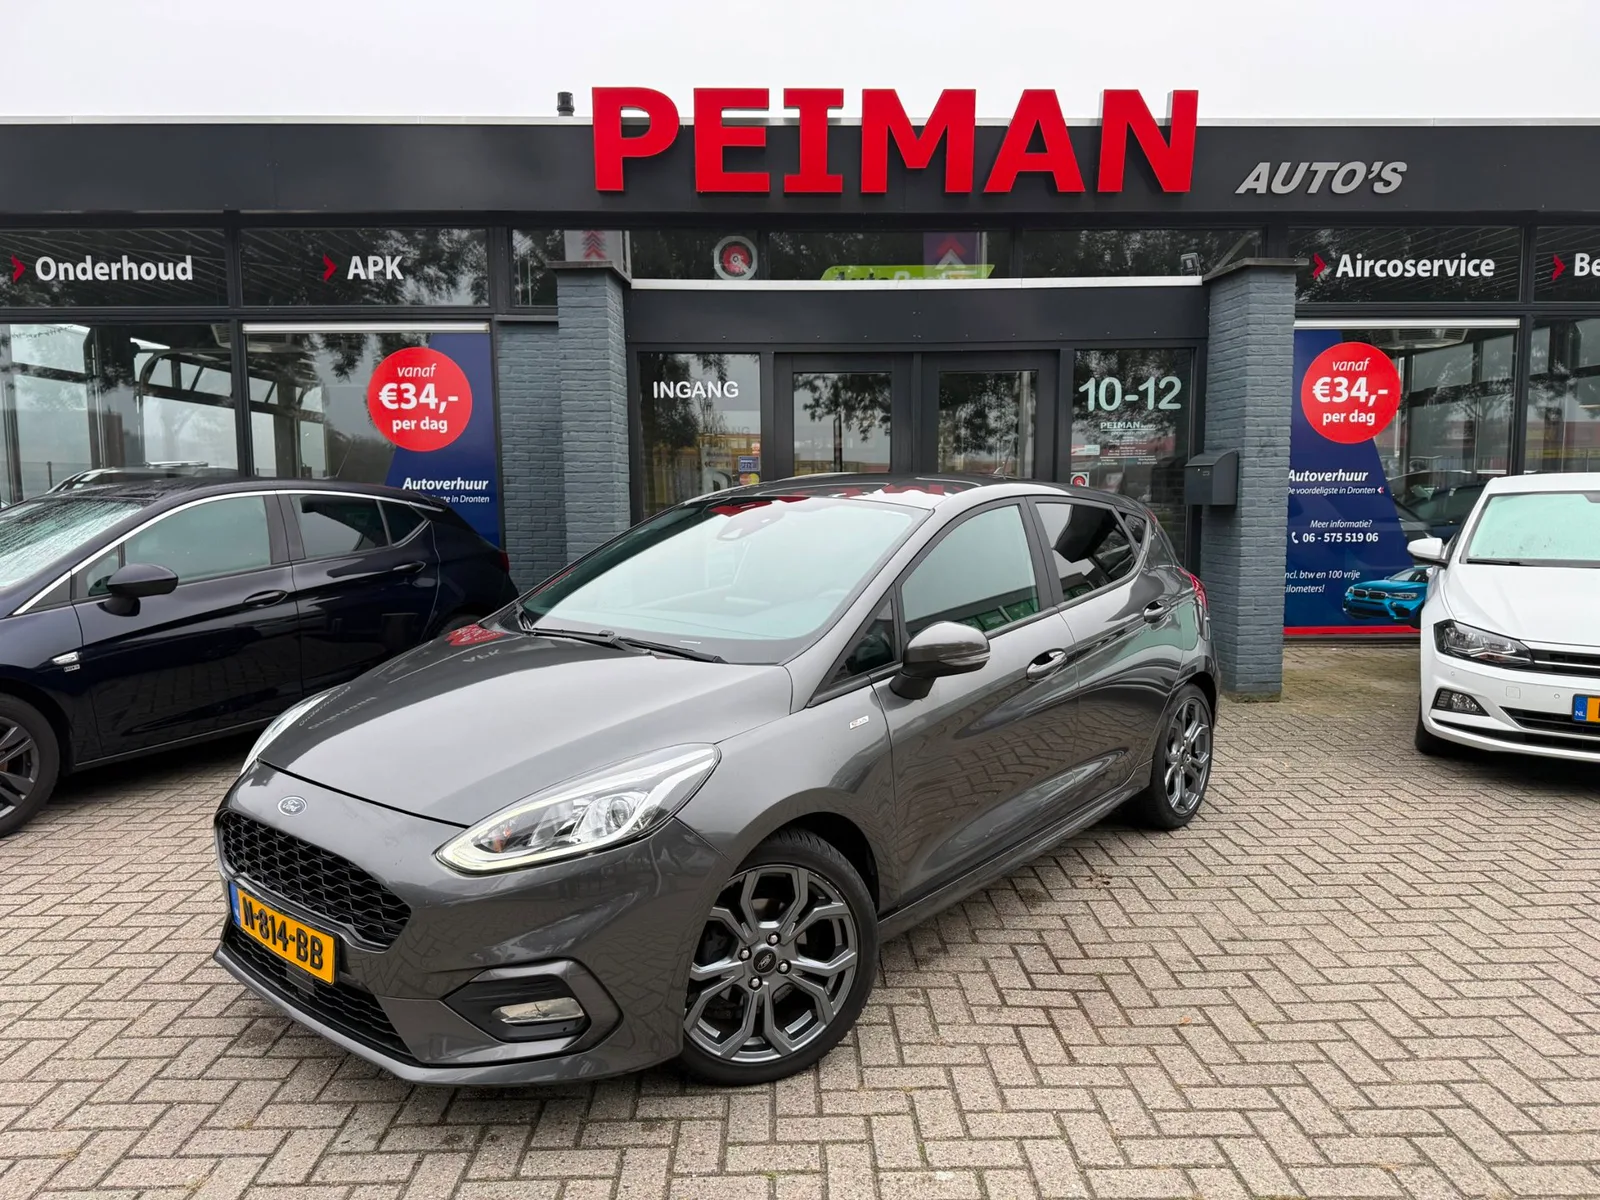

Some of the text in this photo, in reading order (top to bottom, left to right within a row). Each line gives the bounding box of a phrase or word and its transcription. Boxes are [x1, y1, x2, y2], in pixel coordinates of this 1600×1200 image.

[591, 86, 1409, 195] PEIMAN AUTO'S
[35, 255, 193, 281] Onderhoud
[346, 255, 404, 281] APK
[1335, 252, 1496, 279] Aircoservice
[397, 363, 437, 378] vanaf
[1332, 357, 1371, 371] vanaf
[652, 380, 739, 399] INGANG
[1078, 376, 1182, 412] 10-12
[1312, 376, 1389, 407] €34,-
[378, 382, 459, 414] €34,-
[392, 416, 448, 433] per dag
[1100, 421, 1140, 429] PEIMAN
[1322, 409, 1375, 426] per dag
[1288, 469, 1369, 482] Autoverhuur
[402, 477, 489, 491] Autoverhuur
[1296, 486, 1338, 497] voordeligste
[1339, 486, 1346, 495] in
[1347, 486, 1376, 495] Dronten
[451, 495, 459, 503] in
[459, 494, 490, 503] Dronten
[1309, 519, 1373, 528] Meer informatie?
[1302, 532, 1316, 543] 06
[1323, 532, 1343, 543] 575
[1344, 532, 1363, 543] 519
[1365, 532, 1379, 543] 06
[1285, 569, 1361, 581] ncl. btw en 100 vrije
[1285, 584, 1325, 593] ilometers!
[242, 896, 324, 970] N-814-BB
